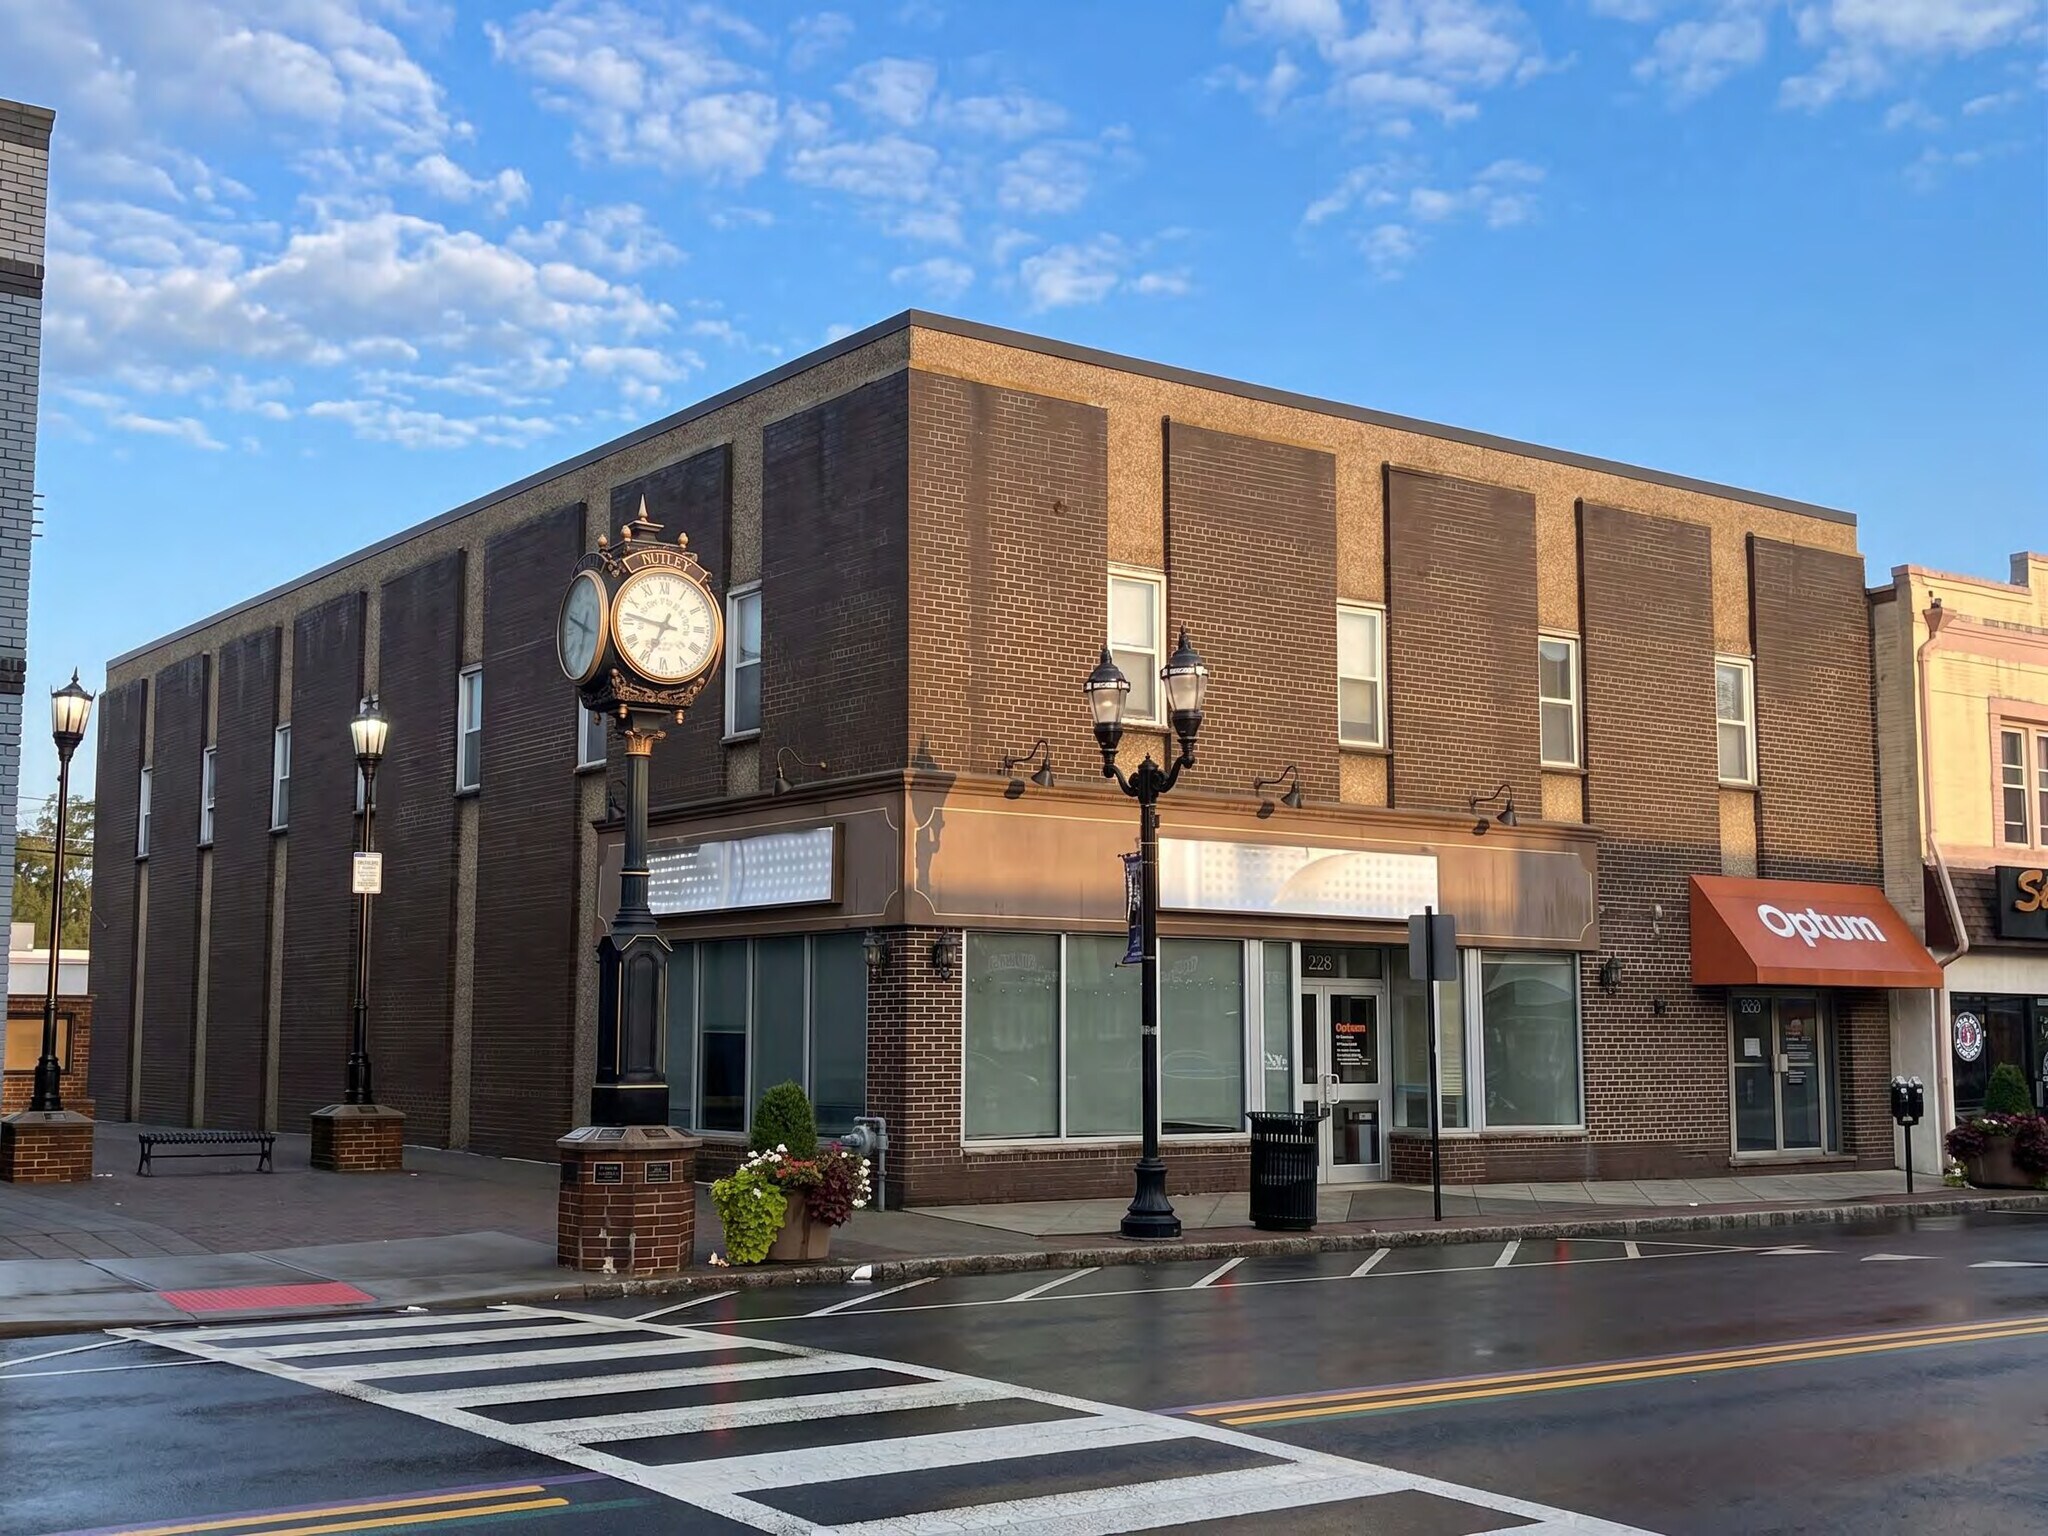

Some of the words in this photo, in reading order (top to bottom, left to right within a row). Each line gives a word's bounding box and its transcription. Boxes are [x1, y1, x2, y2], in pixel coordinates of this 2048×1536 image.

[641, 553, 692, 572] NUTLEY
[1757, 904, 1887, 948] Optum
[1309, 955, 1332, 971] 228
